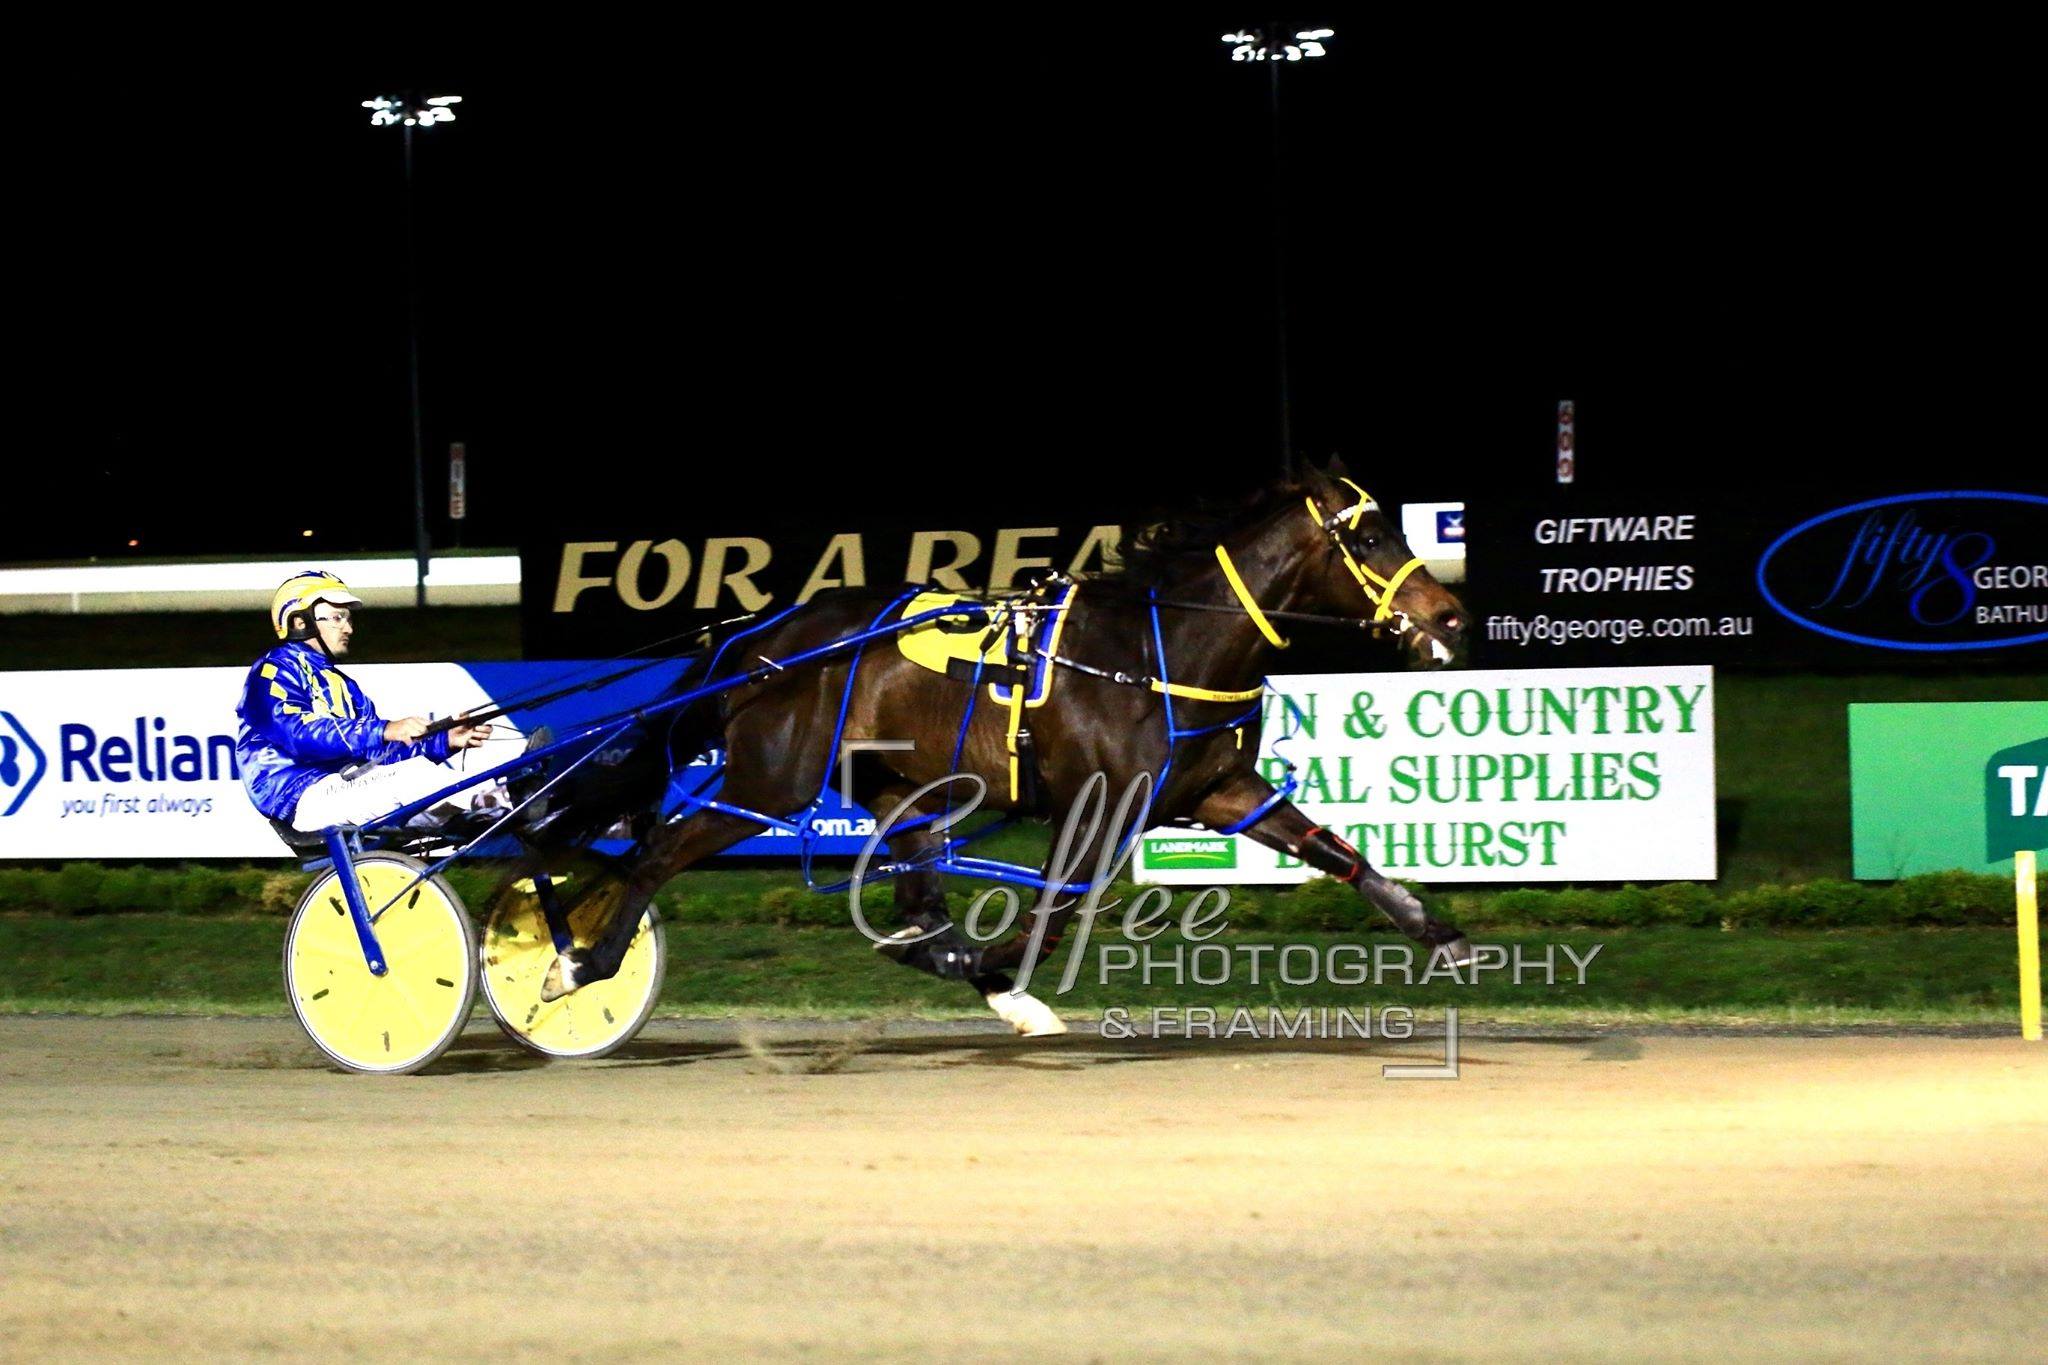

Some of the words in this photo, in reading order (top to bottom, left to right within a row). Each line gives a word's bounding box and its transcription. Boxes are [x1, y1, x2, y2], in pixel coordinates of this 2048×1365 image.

[1535, 515, 1696, 544] GIFTWARE
[553, 538, 774, 612] FOR
[794, 533, 866, 606] A
[1540, 565, 1695, 593] TROPHIES
[1487, 615, 1753, 646] fifty8george.com.au
[1343, 691, 1387, 739] &
[1405, 684, 1705, 738] COUNTRY
[1389, 751, 1661, 804] SUPPLIES
[61, 800, 96, 818] you
[100, 793, 140, 817] first
[146, 794, 213, 817] always
